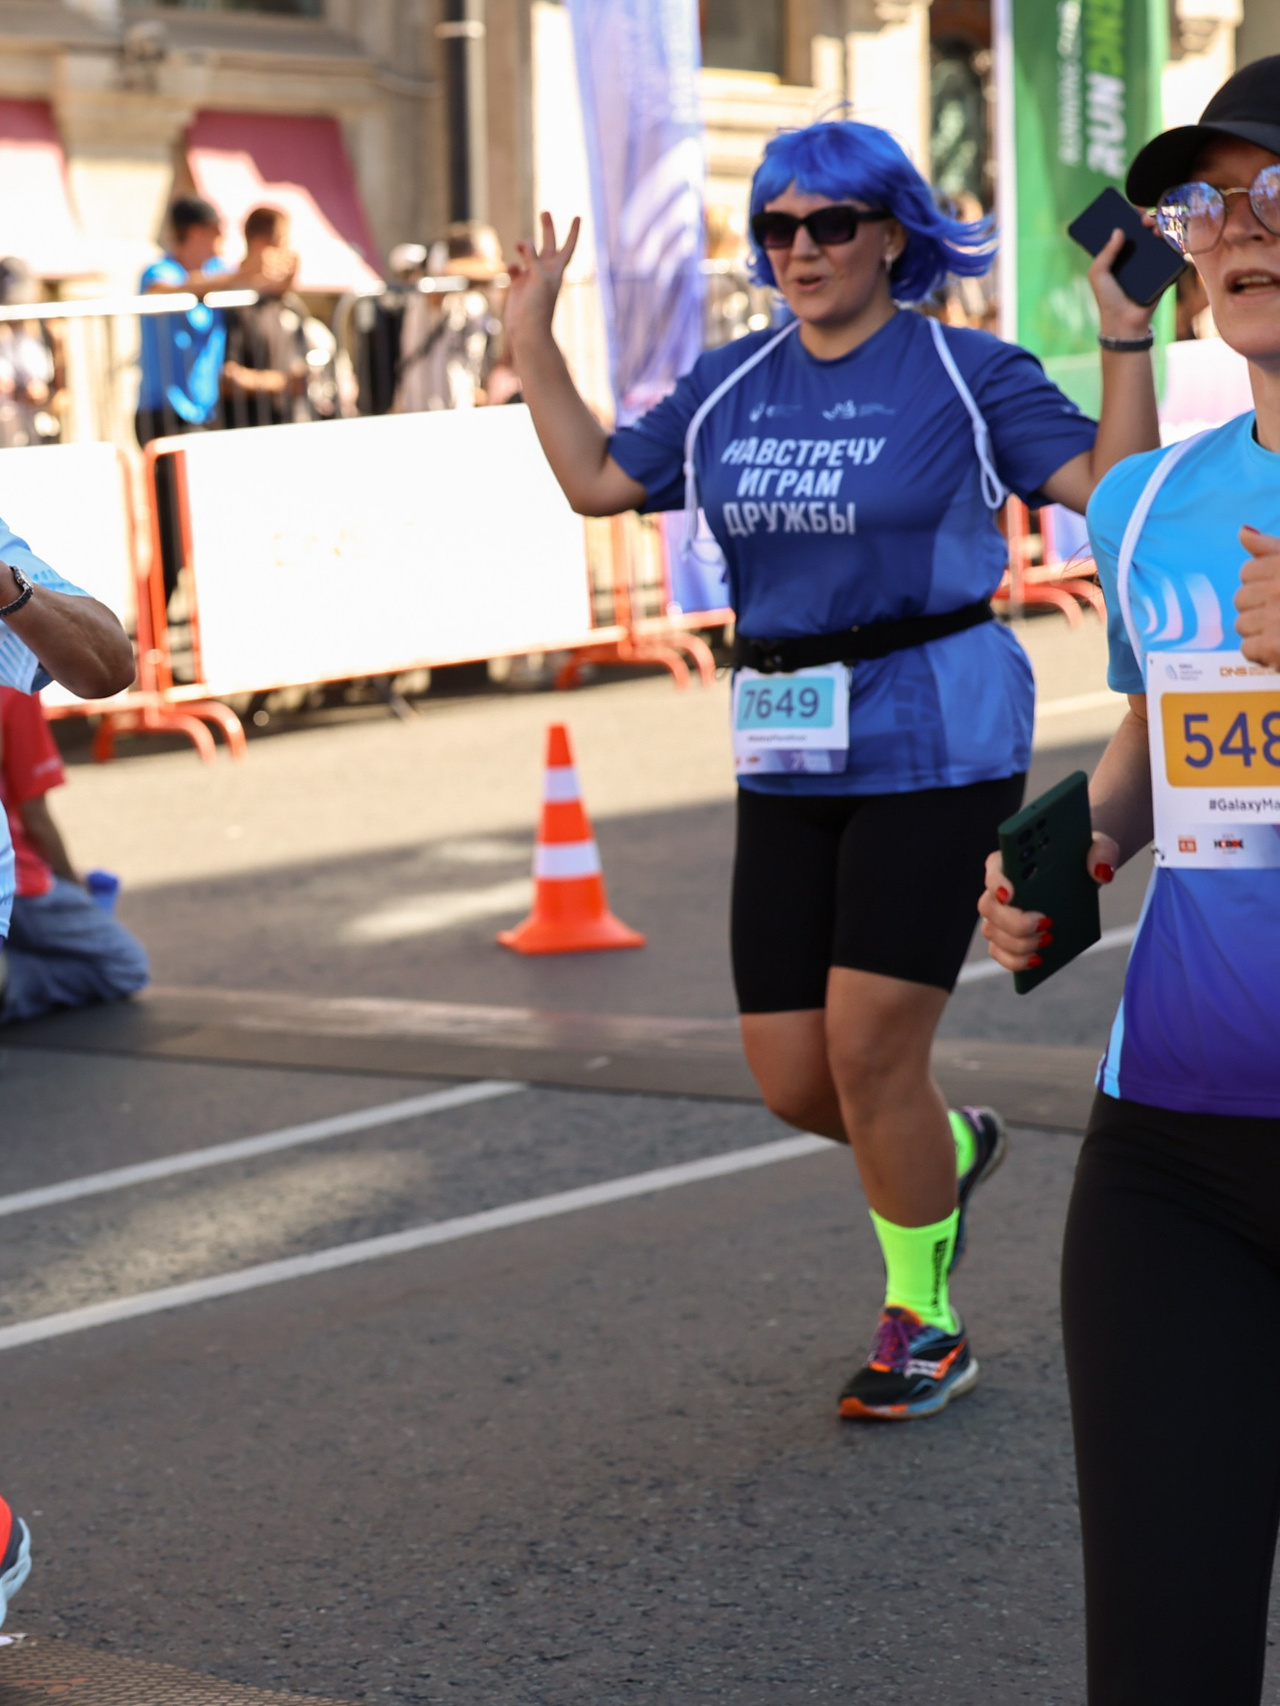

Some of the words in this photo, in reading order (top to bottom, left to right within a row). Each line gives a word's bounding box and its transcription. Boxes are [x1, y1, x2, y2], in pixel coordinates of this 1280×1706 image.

[720, 436, 887, 467] НАВСТРЕЧУ
[735, 467, 845, 498] ИГРАМ
[722, 501, 857, 538] ДРУЖБЫ
[742, 687, 820, 720] 7649
[1209, 796, 1280, 813] #GalaxyMa
